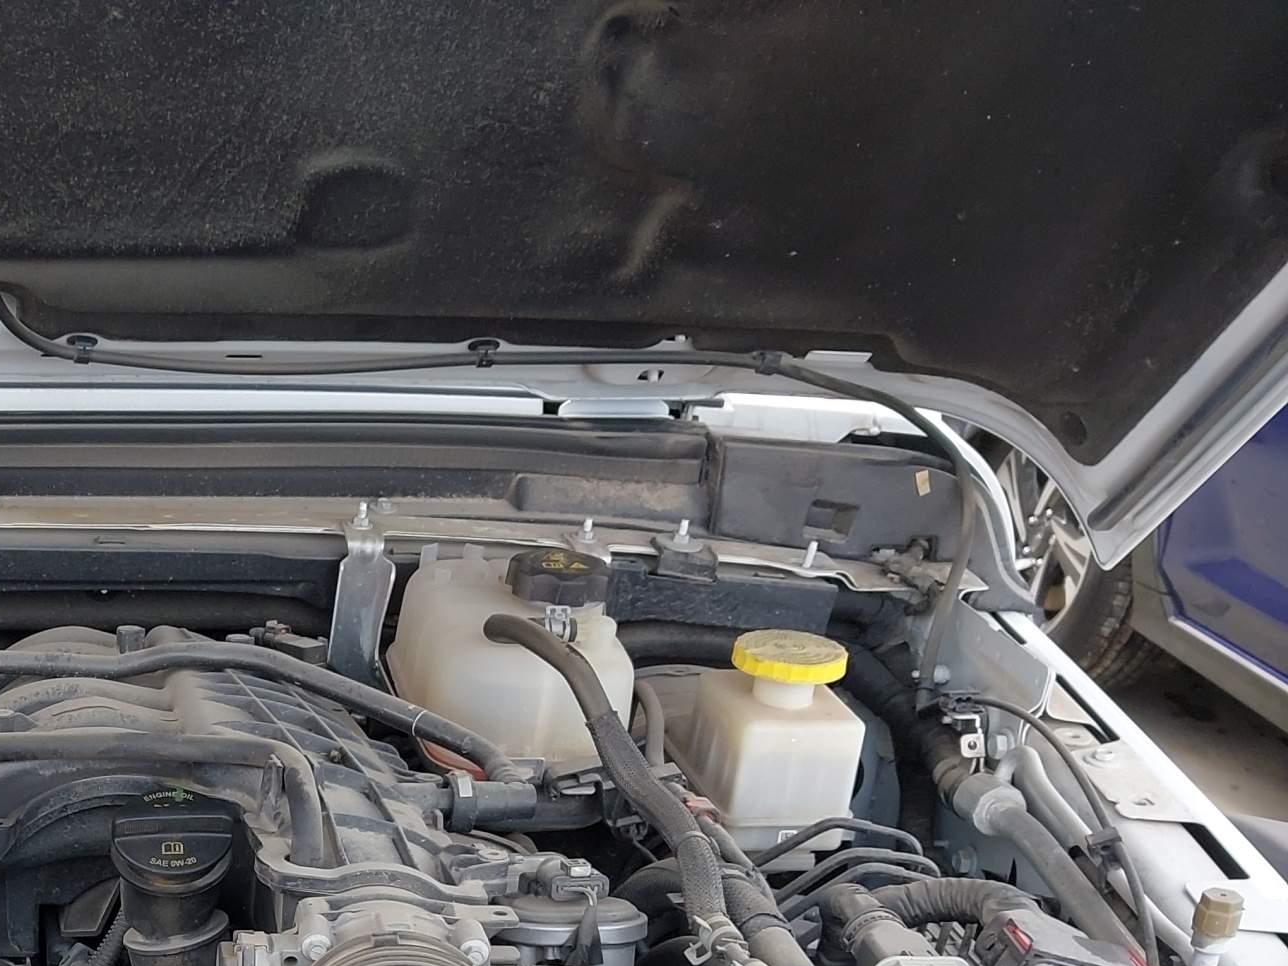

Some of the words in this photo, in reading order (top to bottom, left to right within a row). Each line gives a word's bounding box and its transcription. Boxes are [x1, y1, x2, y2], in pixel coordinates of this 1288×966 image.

[181, 791, 195, 801] OIL
[149, 857, 169, 867] SAE
[170, 856, 197, 868] 0W-20
